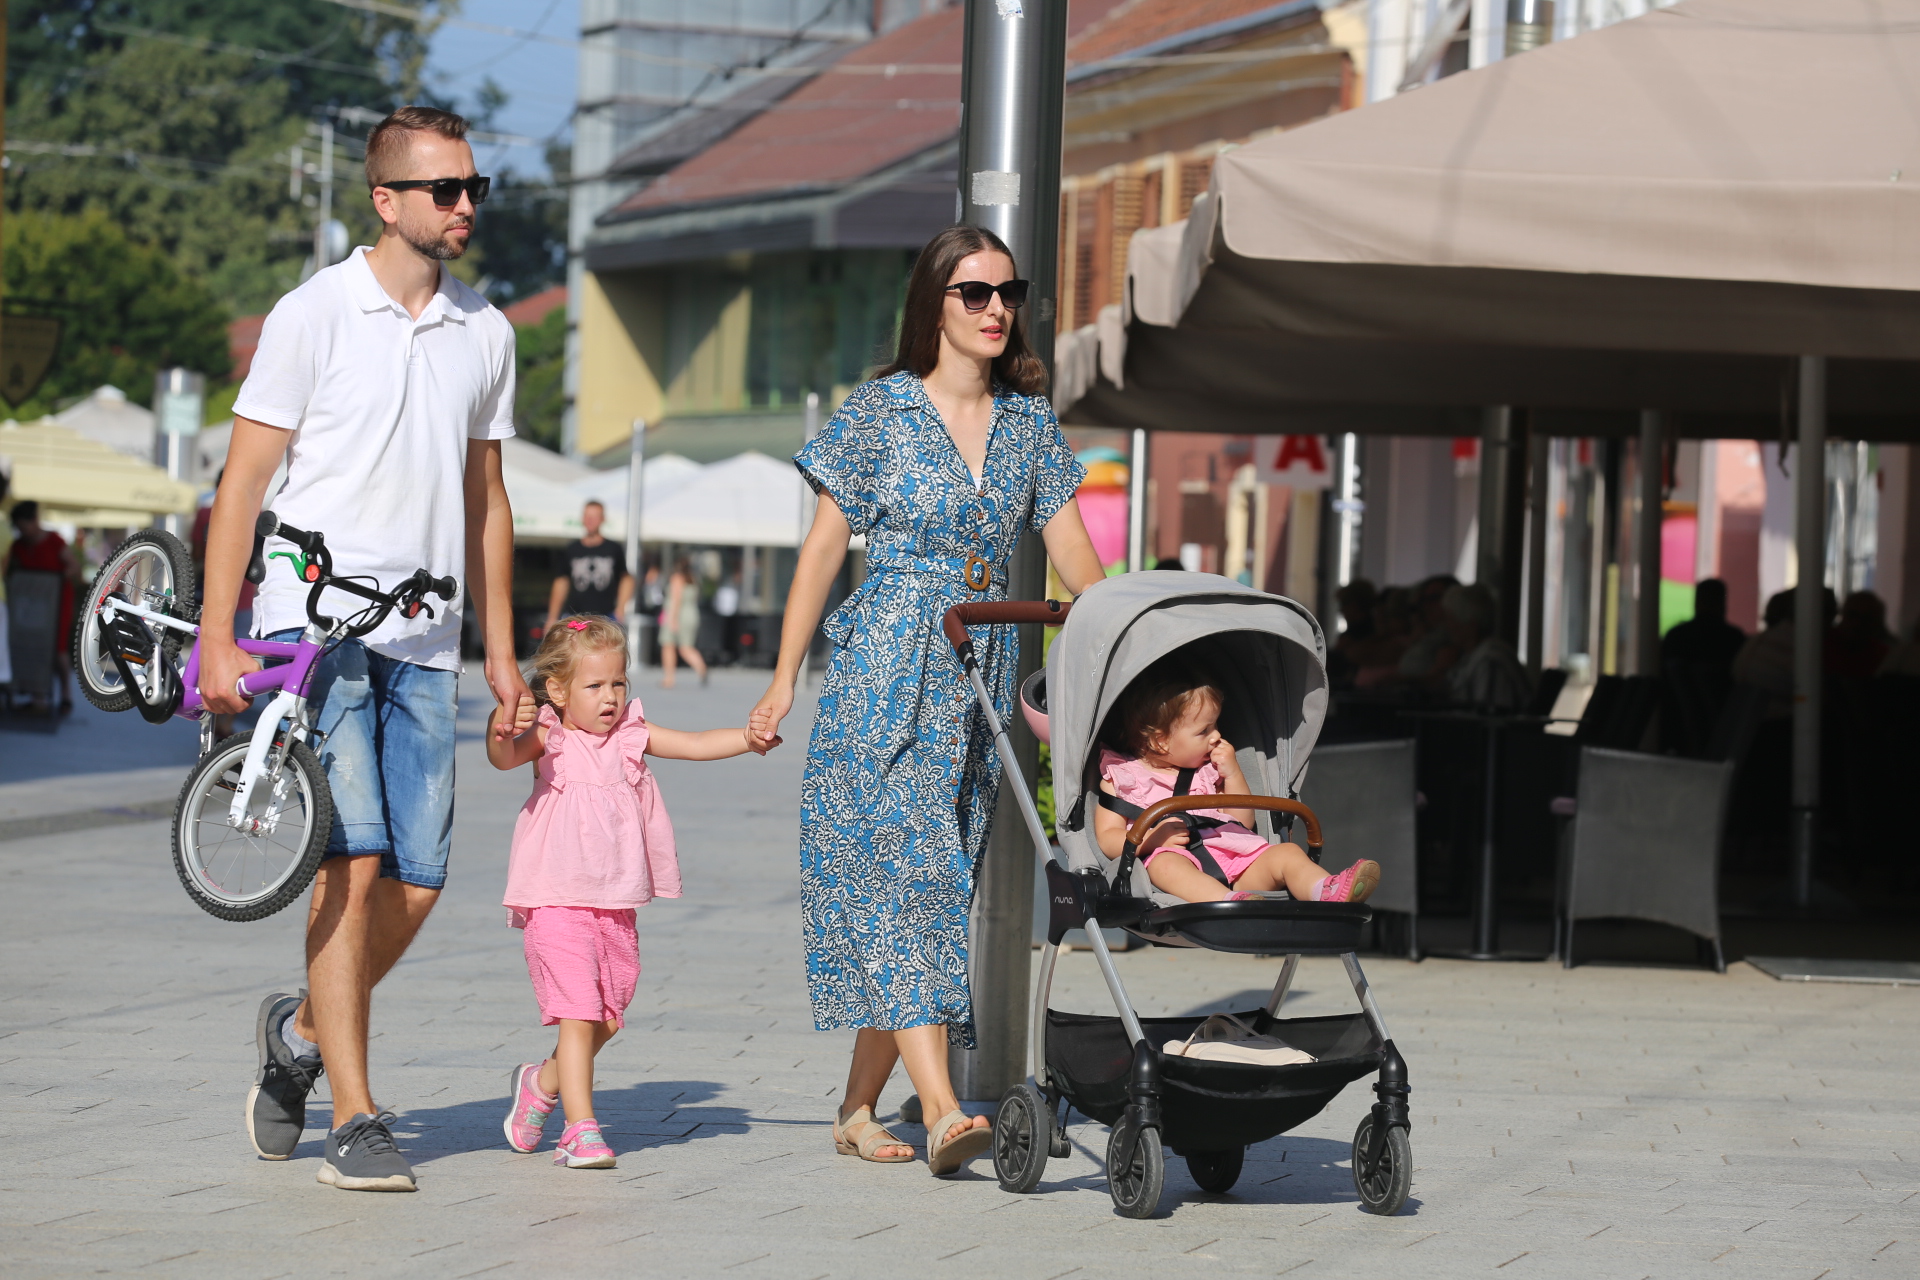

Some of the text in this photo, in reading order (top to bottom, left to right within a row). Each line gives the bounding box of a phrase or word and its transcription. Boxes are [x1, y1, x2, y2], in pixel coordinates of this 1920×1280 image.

[236, 780, 246, 793] 14
[189, 881, 201, 892] JOE
[199, 892, 225, 907] LITTLE
[1054, 895, 1074, 905] nuna
